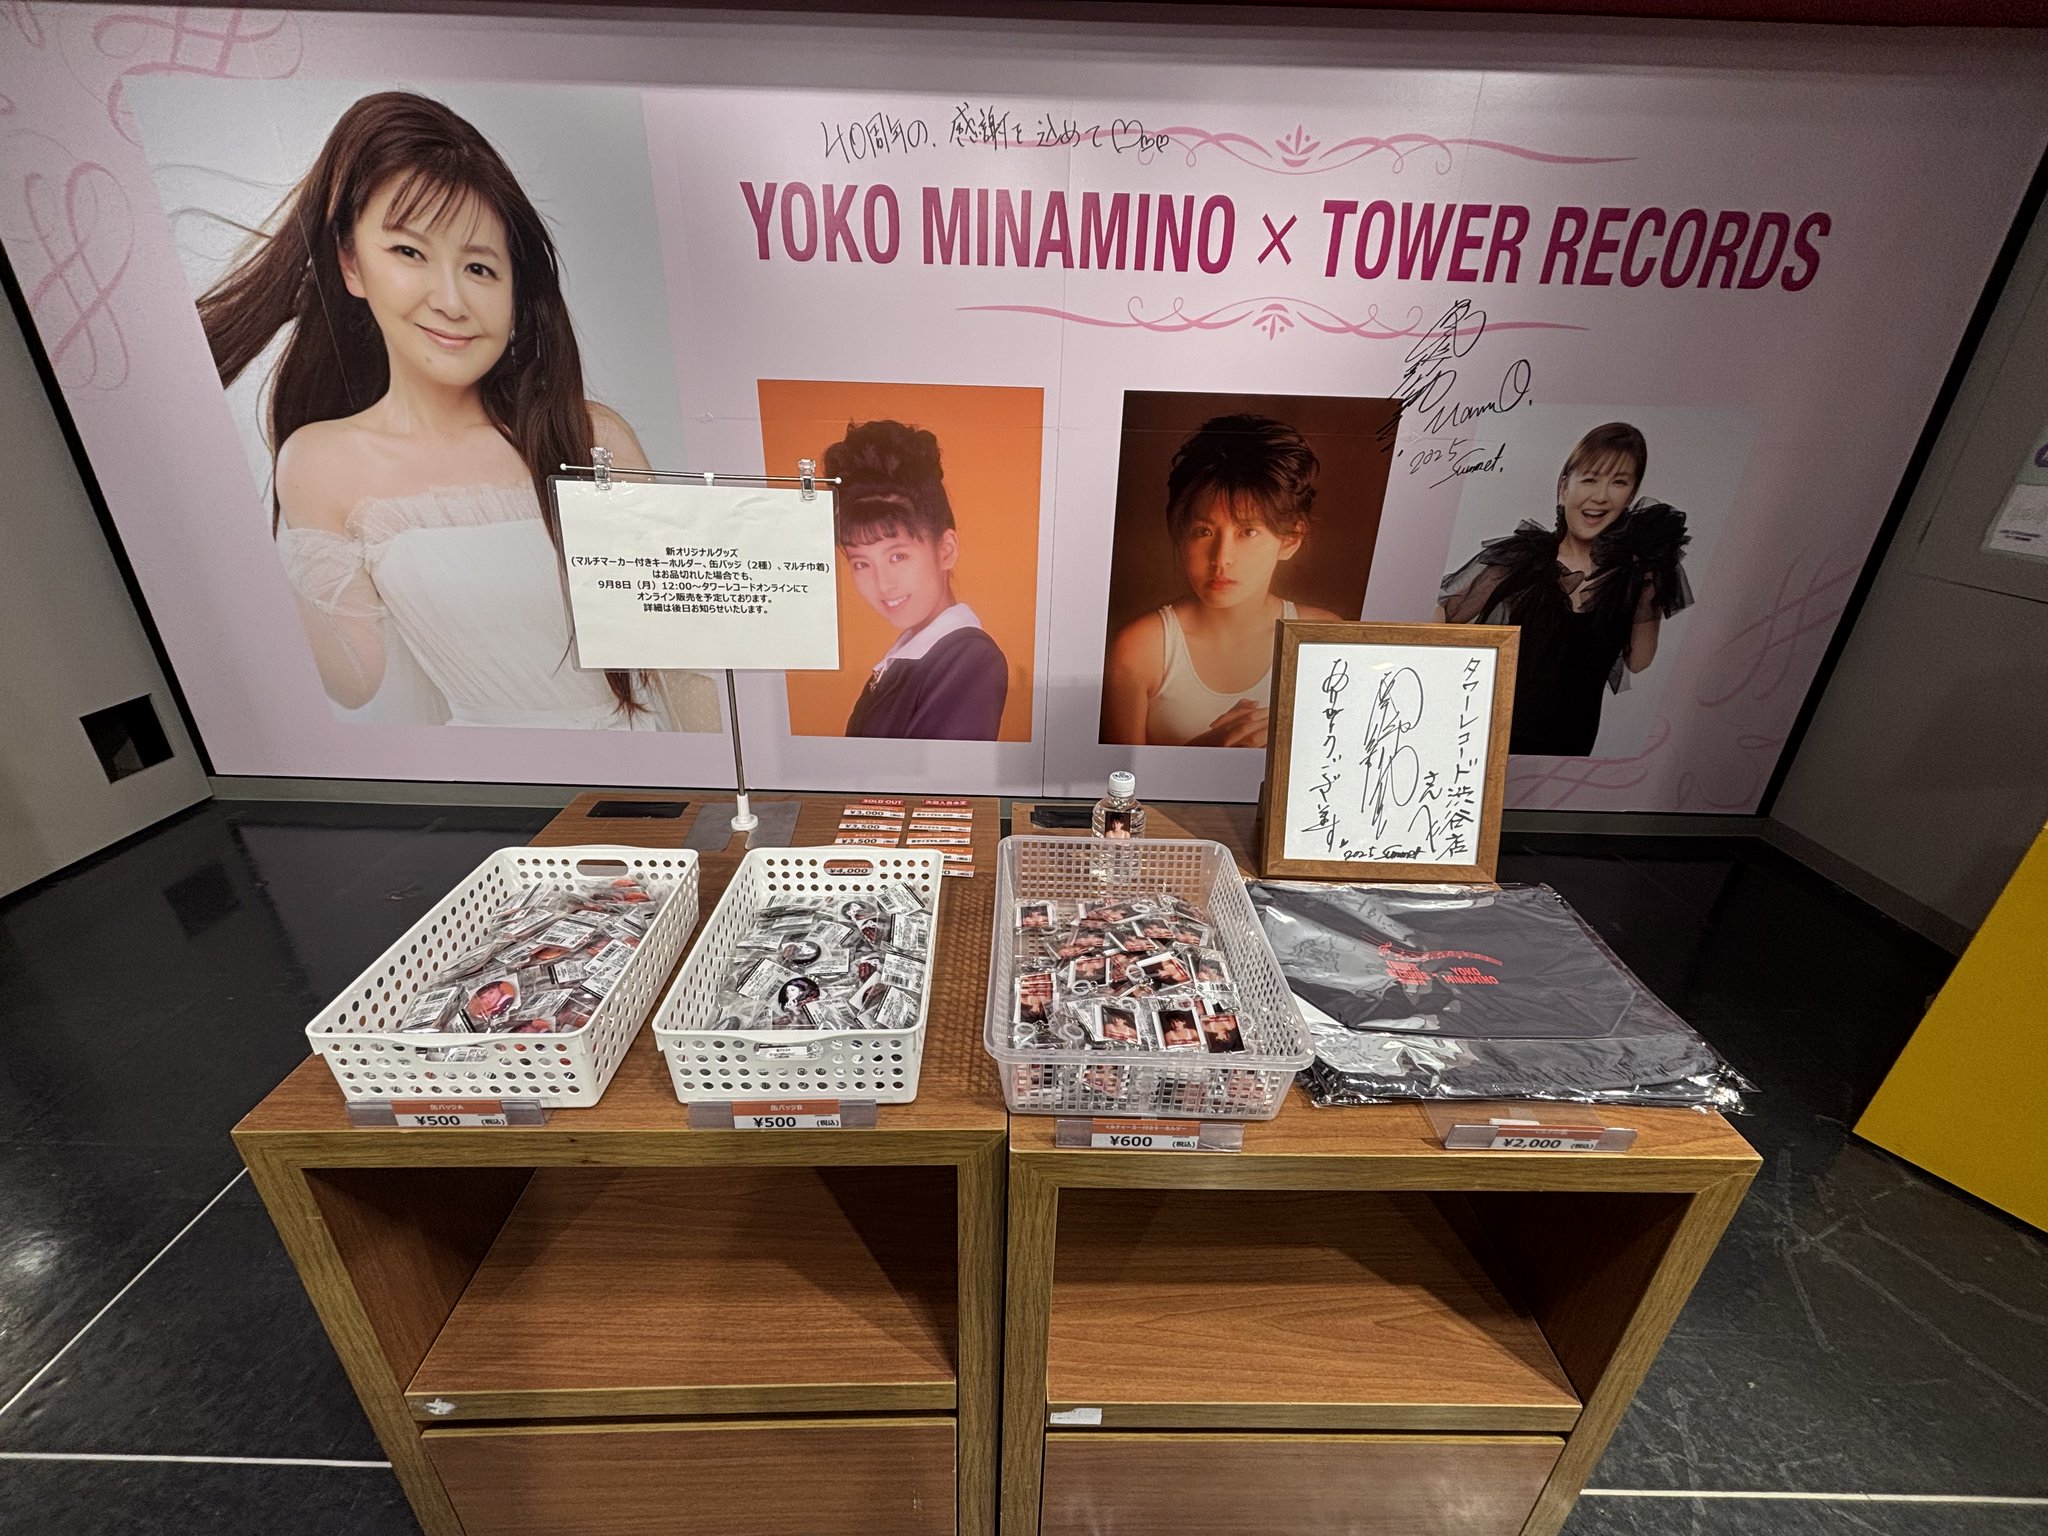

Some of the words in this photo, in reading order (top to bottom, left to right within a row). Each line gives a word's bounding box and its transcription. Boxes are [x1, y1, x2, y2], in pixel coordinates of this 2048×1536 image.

[740, 181, 901, 264] YOKO
[922, 186, 1236, 275] MINAMINO
[1321, 199, 1532, 284] TOWER
[1538, 206, 1832, 292] RECORDS
[1410, 437, 1469, 475] 2025
[665, 547, 739, 558] 新オリジナルグッズ
[652, 570, 753, 581] はお品切れした場合でも、
[637, 592, 773, 604] オンライン販売を予定しております。
[643, 603, 768, 614] 詳細は後日お知らせいたします。
[1450, 966, 1481, 976] YOKO
[1441, 974, 1500, 985] MINAMINO
[414, 1115, 461, 1126] ¥500
[753, 1116, 797, 1128] ¥500
[1110, 1135, 1153, 1147] ¥600
[1503, 1138, 1562, 1149] ¥2,000
